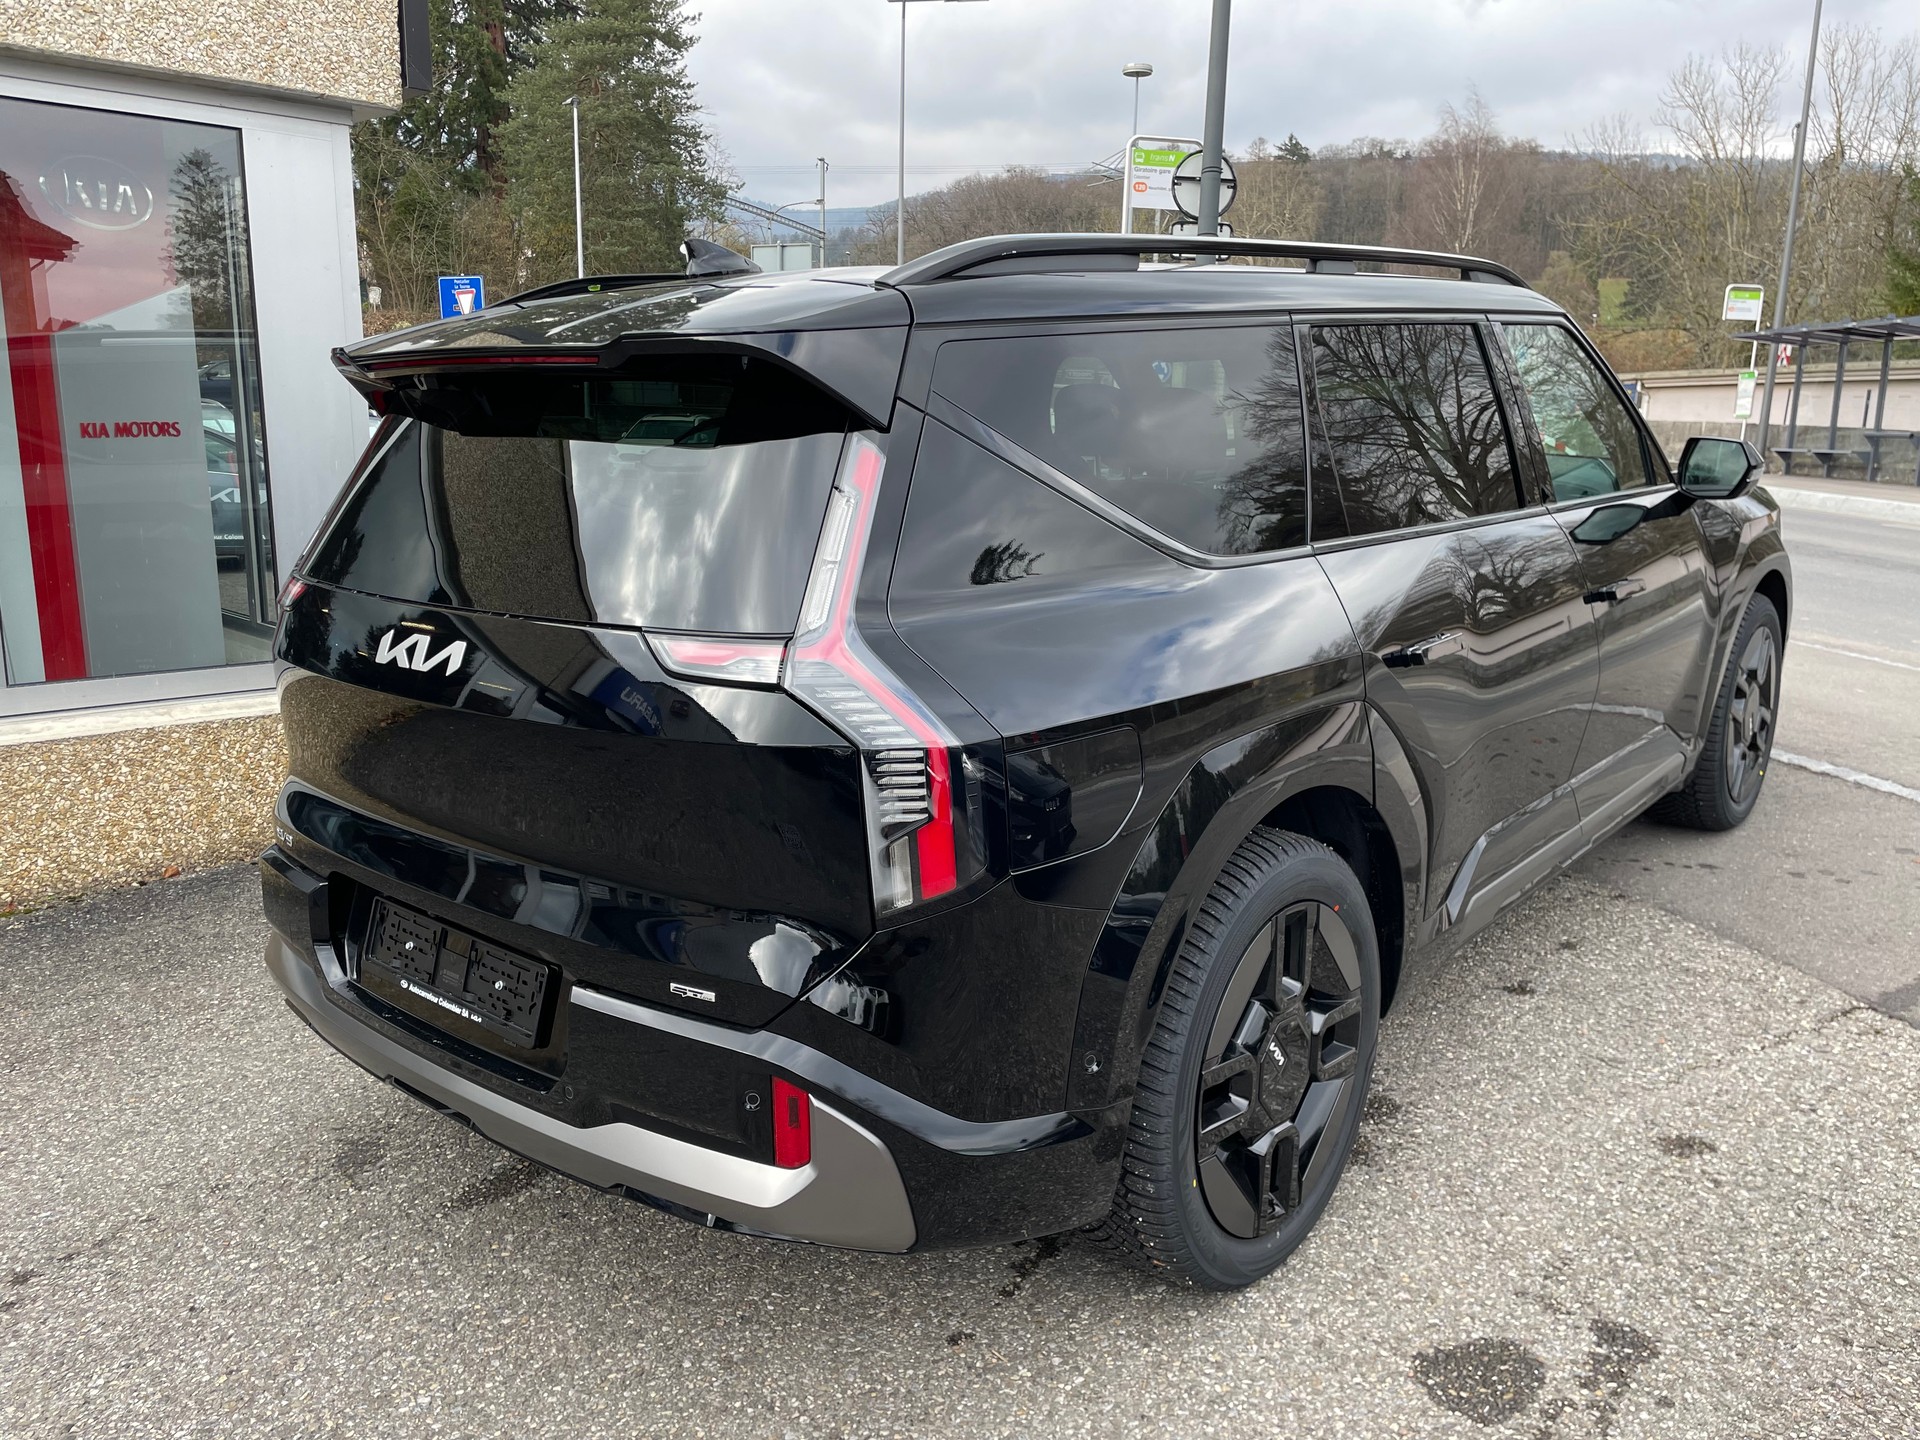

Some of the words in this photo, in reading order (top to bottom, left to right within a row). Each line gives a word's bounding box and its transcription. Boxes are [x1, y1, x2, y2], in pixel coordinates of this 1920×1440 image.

[80, 422, 110, 438] KIA
[113, 421, 181, 438] MOTORS
[375, 629, 467, 677] KIA
